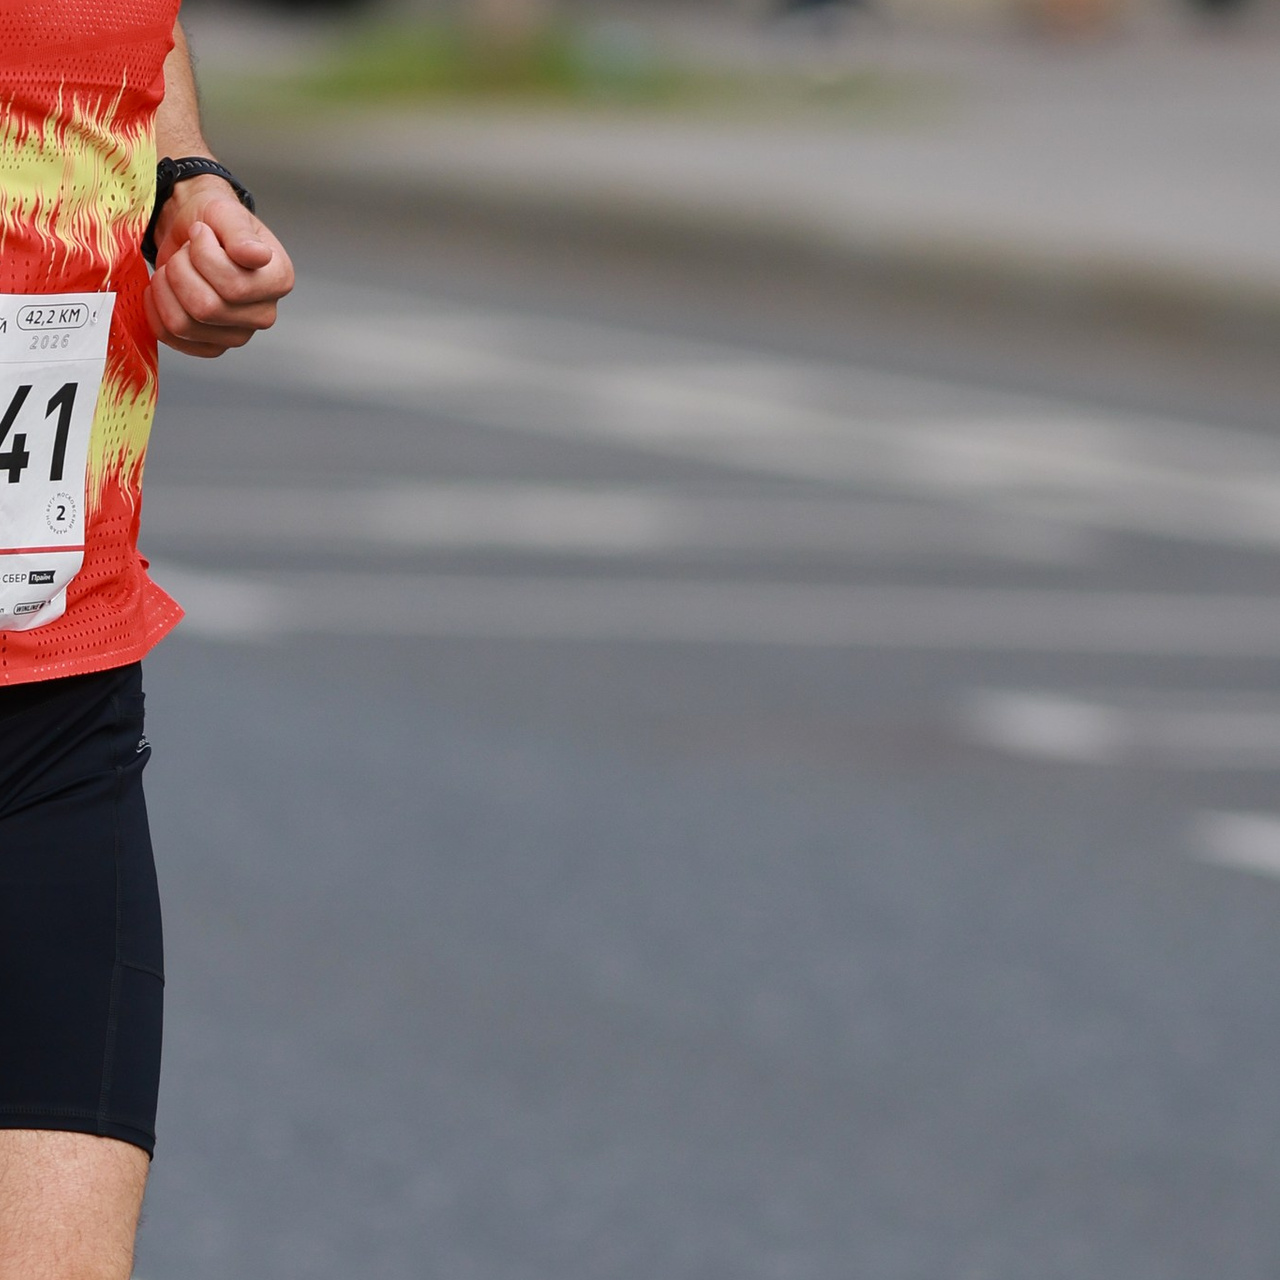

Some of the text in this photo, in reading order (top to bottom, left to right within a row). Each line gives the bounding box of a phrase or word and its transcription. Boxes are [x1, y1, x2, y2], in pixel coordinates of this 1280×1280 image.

[25, 309, 55, 326] 42,2
[29, 333, 70, 350] 2026
[56, 505, 66, 521] 2
[2, 573, 51, 584] СБЕР Прайм
